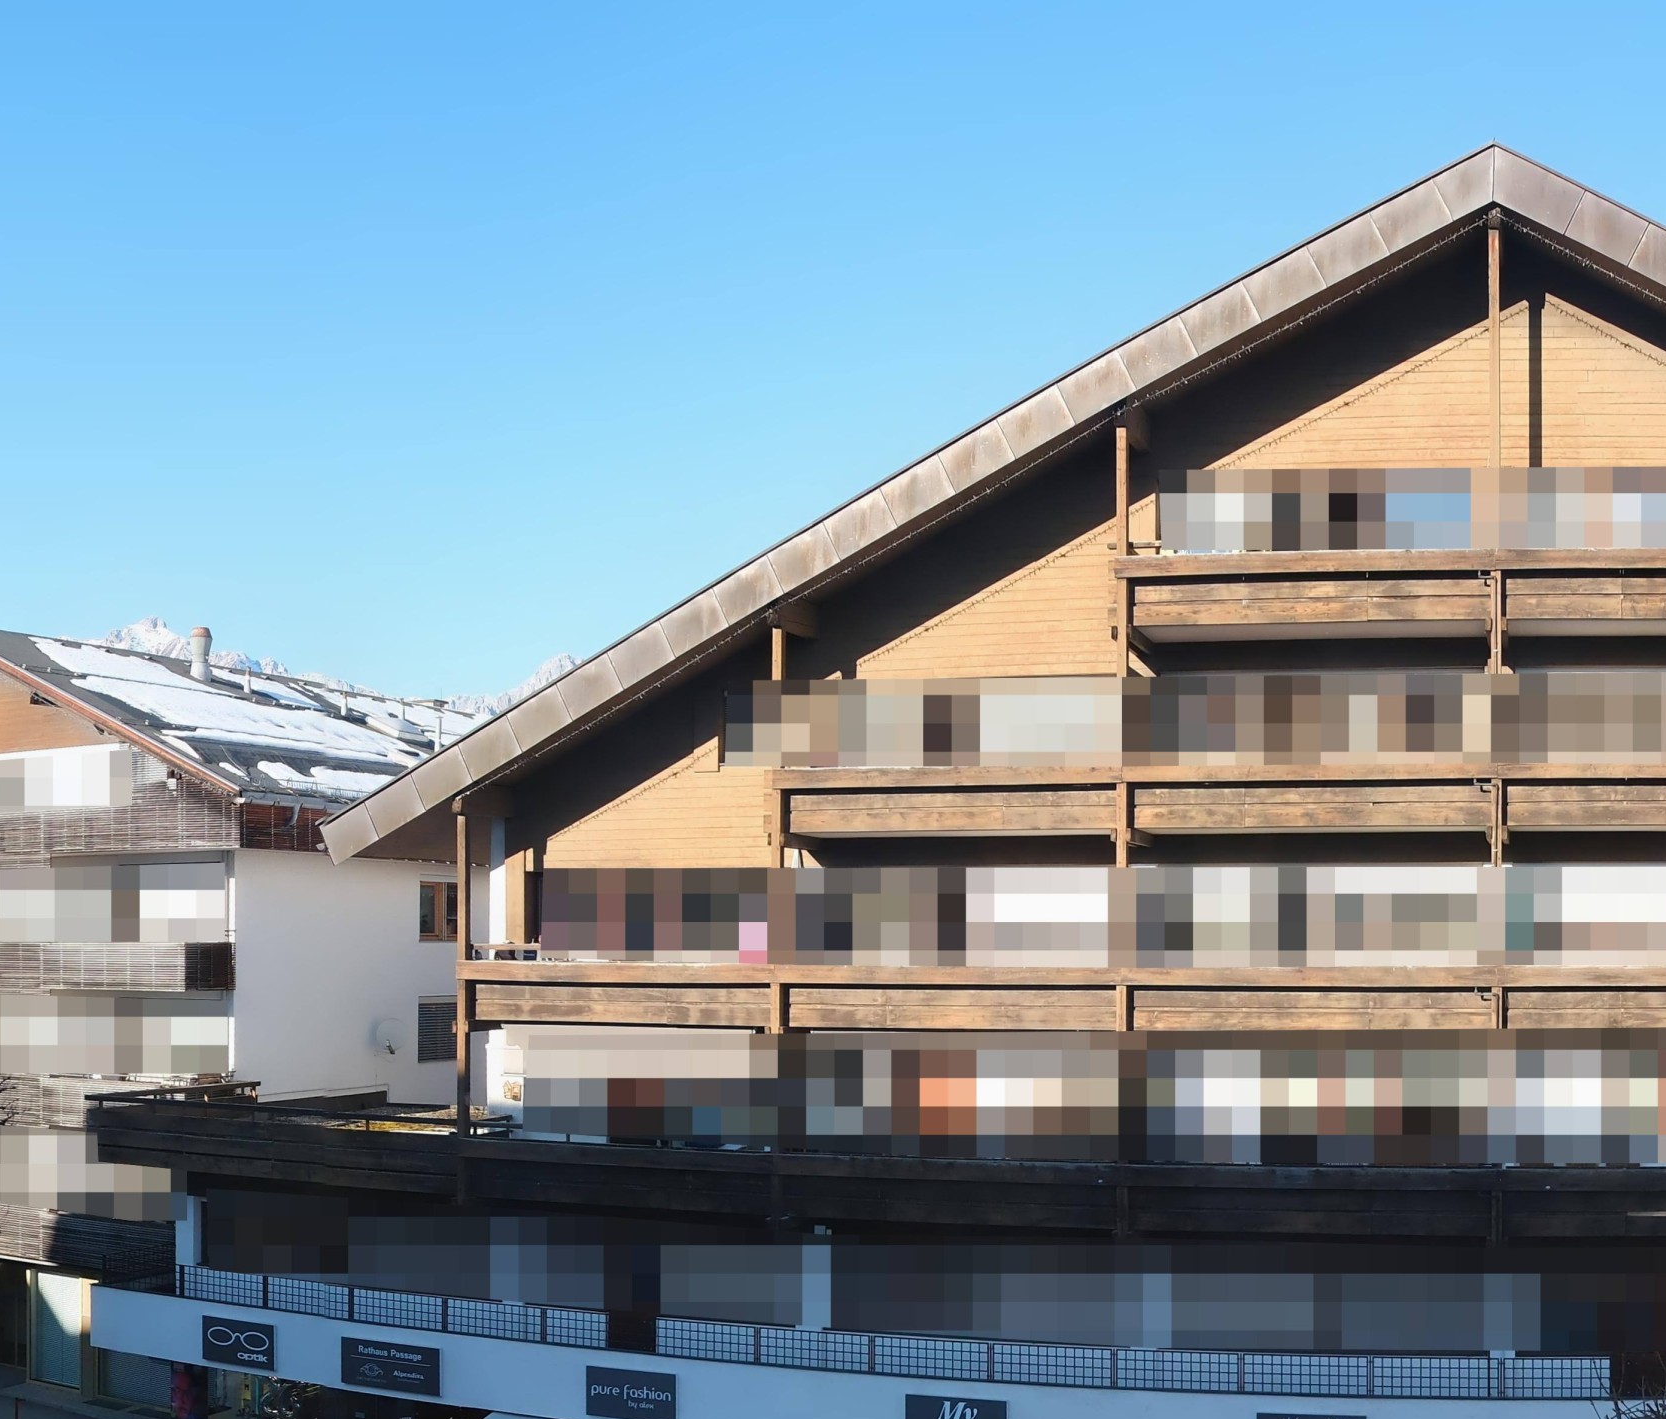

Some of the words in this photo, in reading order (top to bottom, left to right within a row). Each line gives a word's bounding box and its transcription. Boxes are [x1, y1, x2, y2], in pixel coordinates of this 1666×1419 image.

[237, 1352, 268, 1363] optik
[358, 1345, 388, 1357] Rathaus
[390, 1349, 422, 1362] Passage
[591, 1384, 620, 1397] pure
[623, 1384, 672, 1402] fashion
[628, 1400, 637, 1409] by
